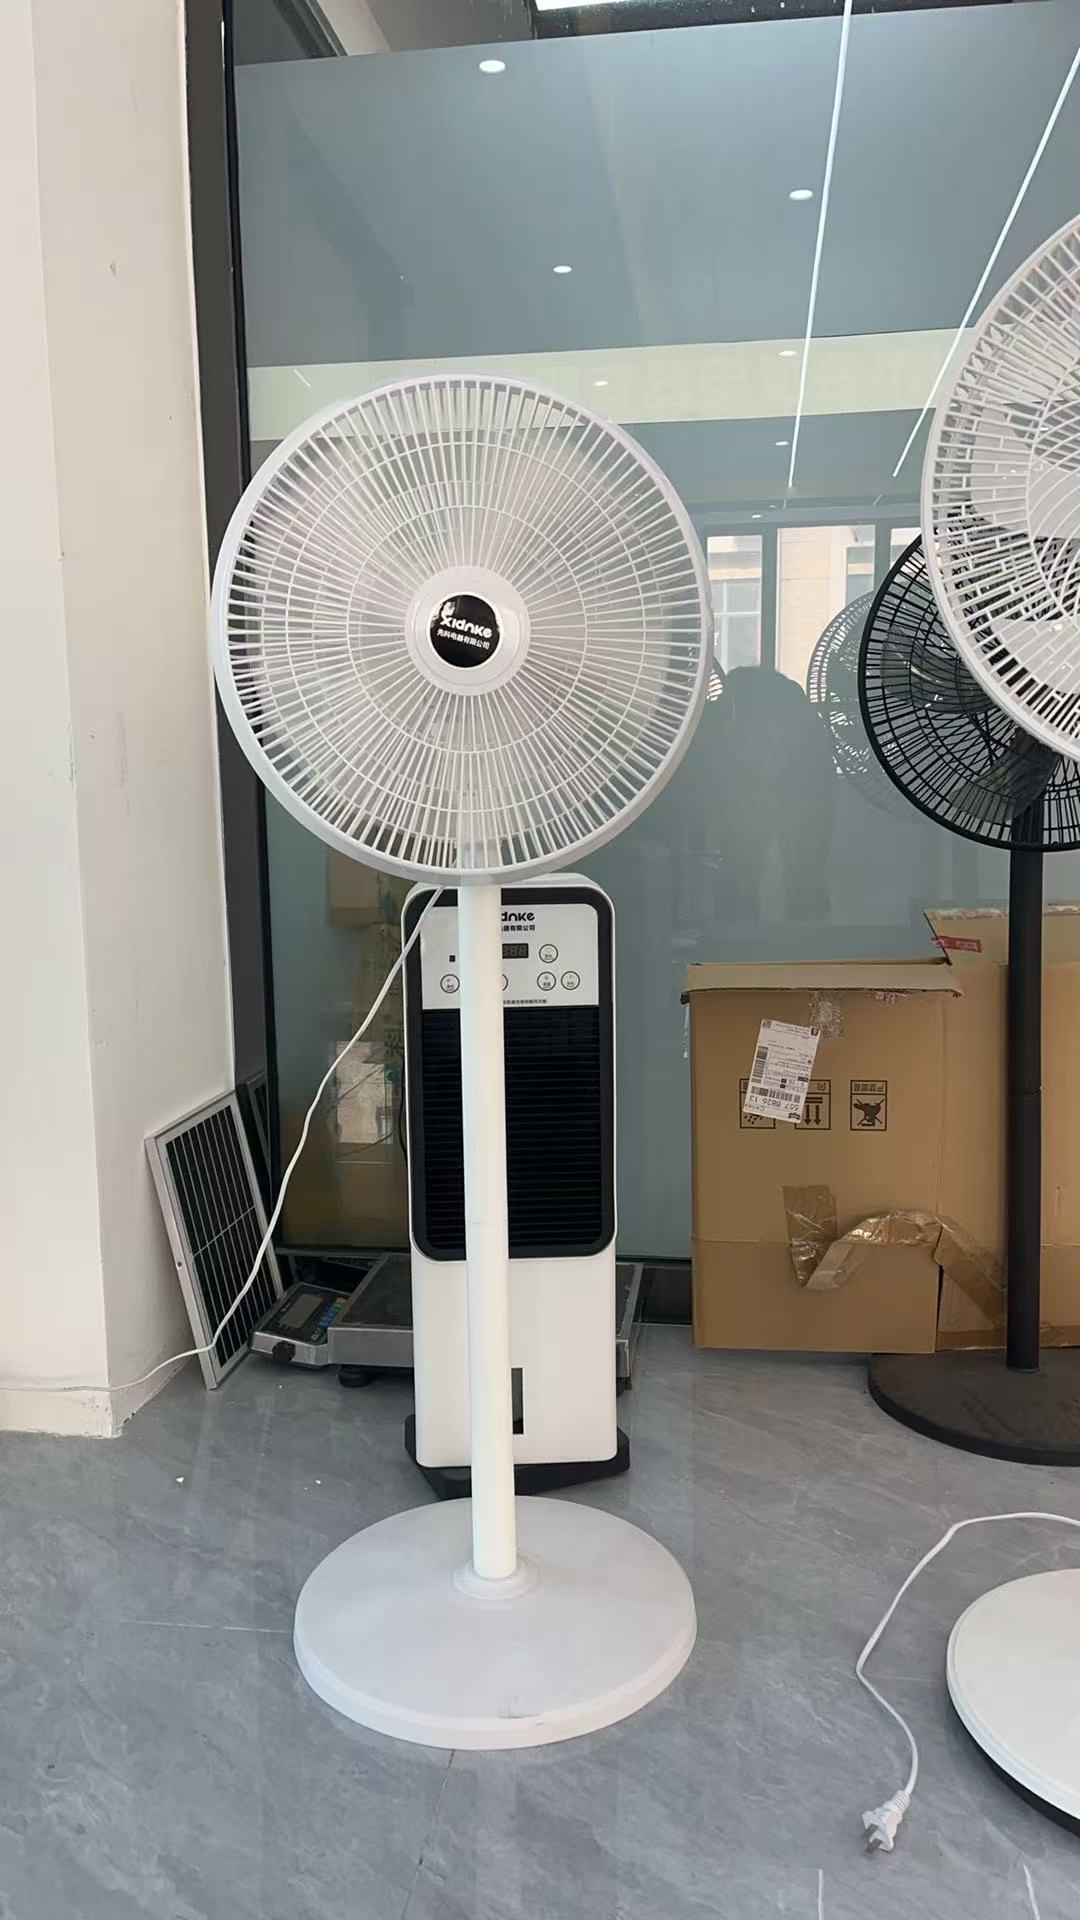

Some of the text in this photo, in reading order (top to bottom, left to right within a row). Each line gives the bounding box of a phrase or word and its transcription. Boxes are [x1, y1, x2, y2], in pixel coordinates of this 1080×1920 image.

[437, 628, 490, 650] 先科电器有限公司
[501, 924, 535, 932] 器有限公司
